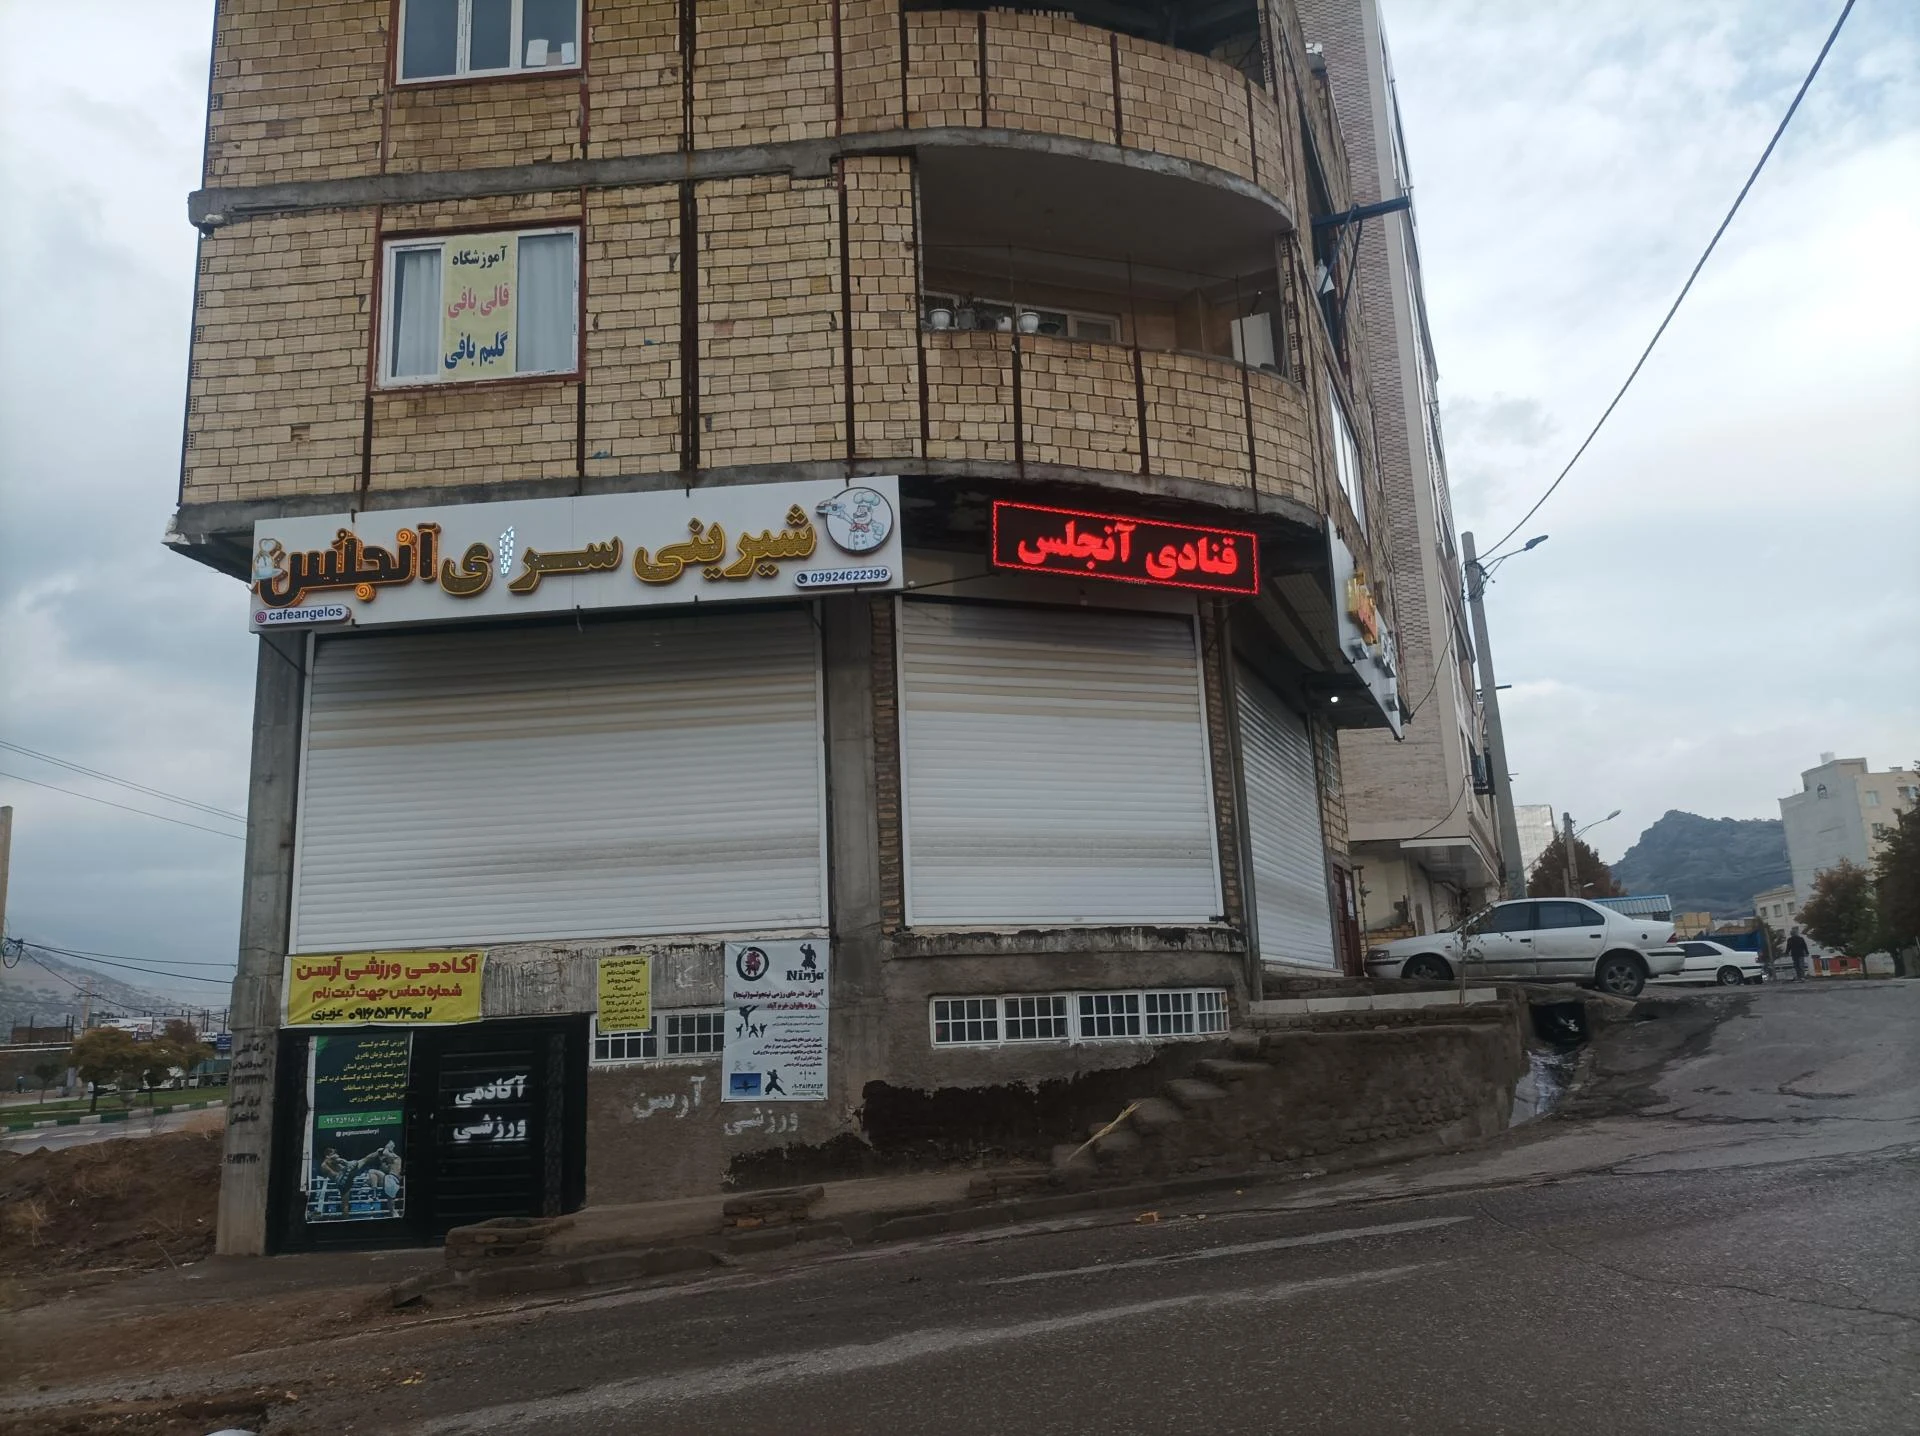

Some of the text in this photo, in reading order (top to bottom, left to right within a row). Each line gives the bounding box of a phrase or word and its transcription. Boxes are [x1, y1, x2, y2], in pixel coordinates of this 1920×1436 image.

[452, 245, 508, 268] آموزشگاه
[448, 283, 510, 318] قالی بافی
[444, 331, 509, 369] گلیم بافی
[254, 503, 817, 606] شیرینی سرای آنجلس
[1017, 520, 1238, 579] قنادی آنجلس
[810, 568, 888, 583] 09924622399
[268, 606, 343, 621] cafeangelos
[296, 953, 479, 981] آکادمی ورزشی آرسن
[786, 969, 824, 983] Ninja
[312, 983, 463, 1003] شماره تماس جهت ثبت نام
[804, 989, 824, 998] آموزش
[311, 1007, 343, 1021] عزیزی
[454, 1074, 528, 1107] آکادمی
[632, 1075, 707, 1119] آرسن
[453, 1114, 527, 1143] ورزشی
[723, 1107, 799, 1136] ورزشی
